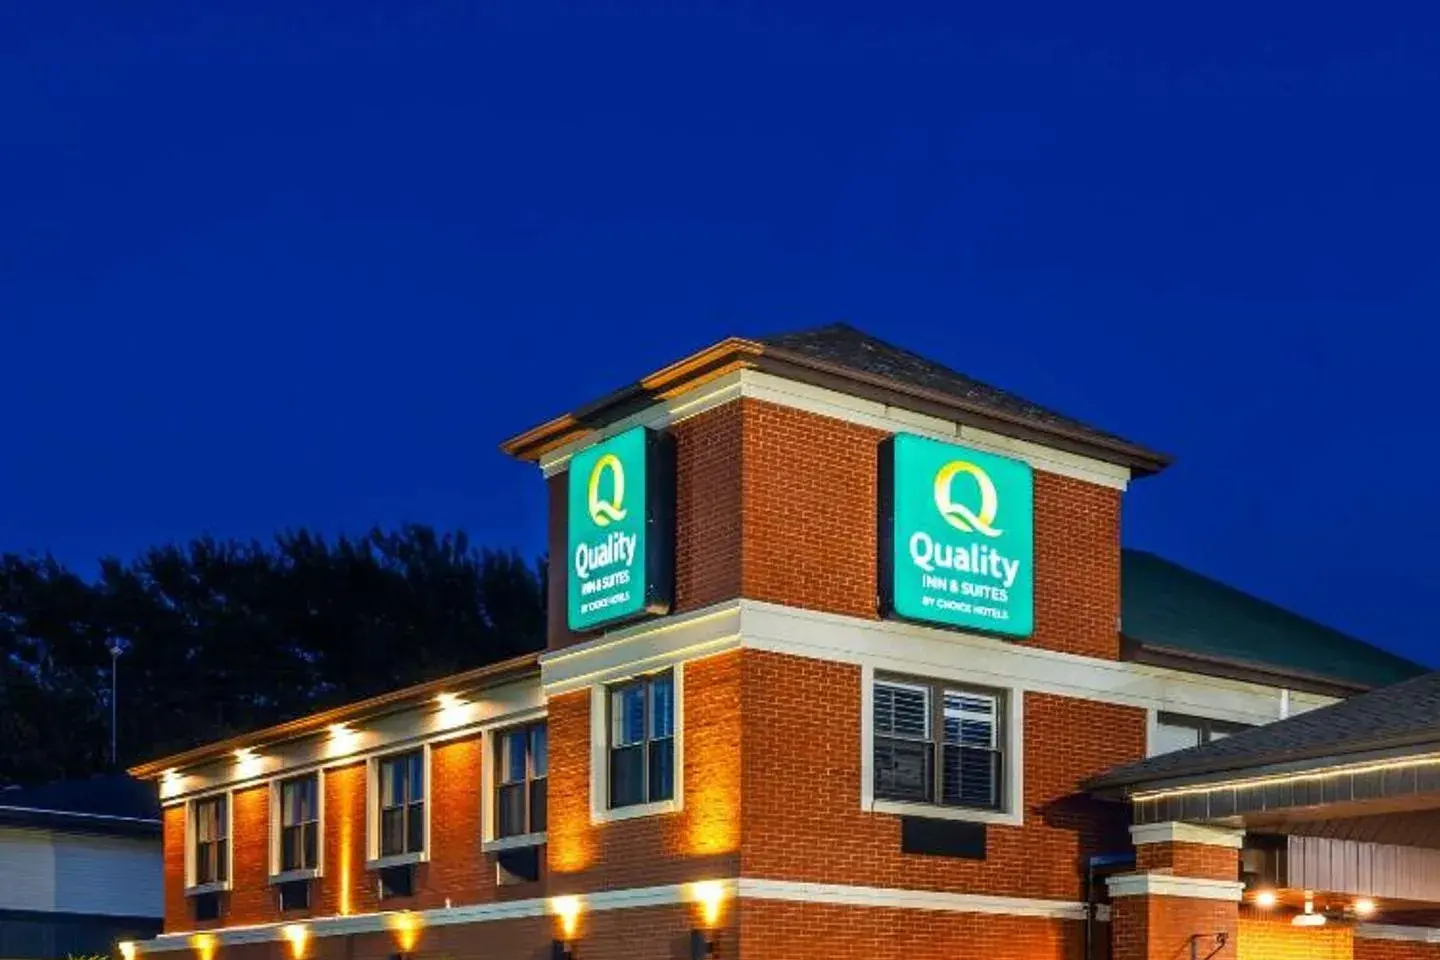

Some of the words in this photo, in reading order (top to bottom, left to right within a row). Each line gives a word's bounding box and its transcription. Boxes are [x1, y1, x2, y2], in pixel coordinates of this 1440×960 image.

[588, 453, 627, 526] Q
[934, 460, 1004, 537] Q
[575, 531, 637, 578] Quality
[909, 531, 1020, 587] Quality
[922, 573, 947, 592] INN
[949, 579, 959, 593] &
[961, 581, 1009, 603] SUITES
